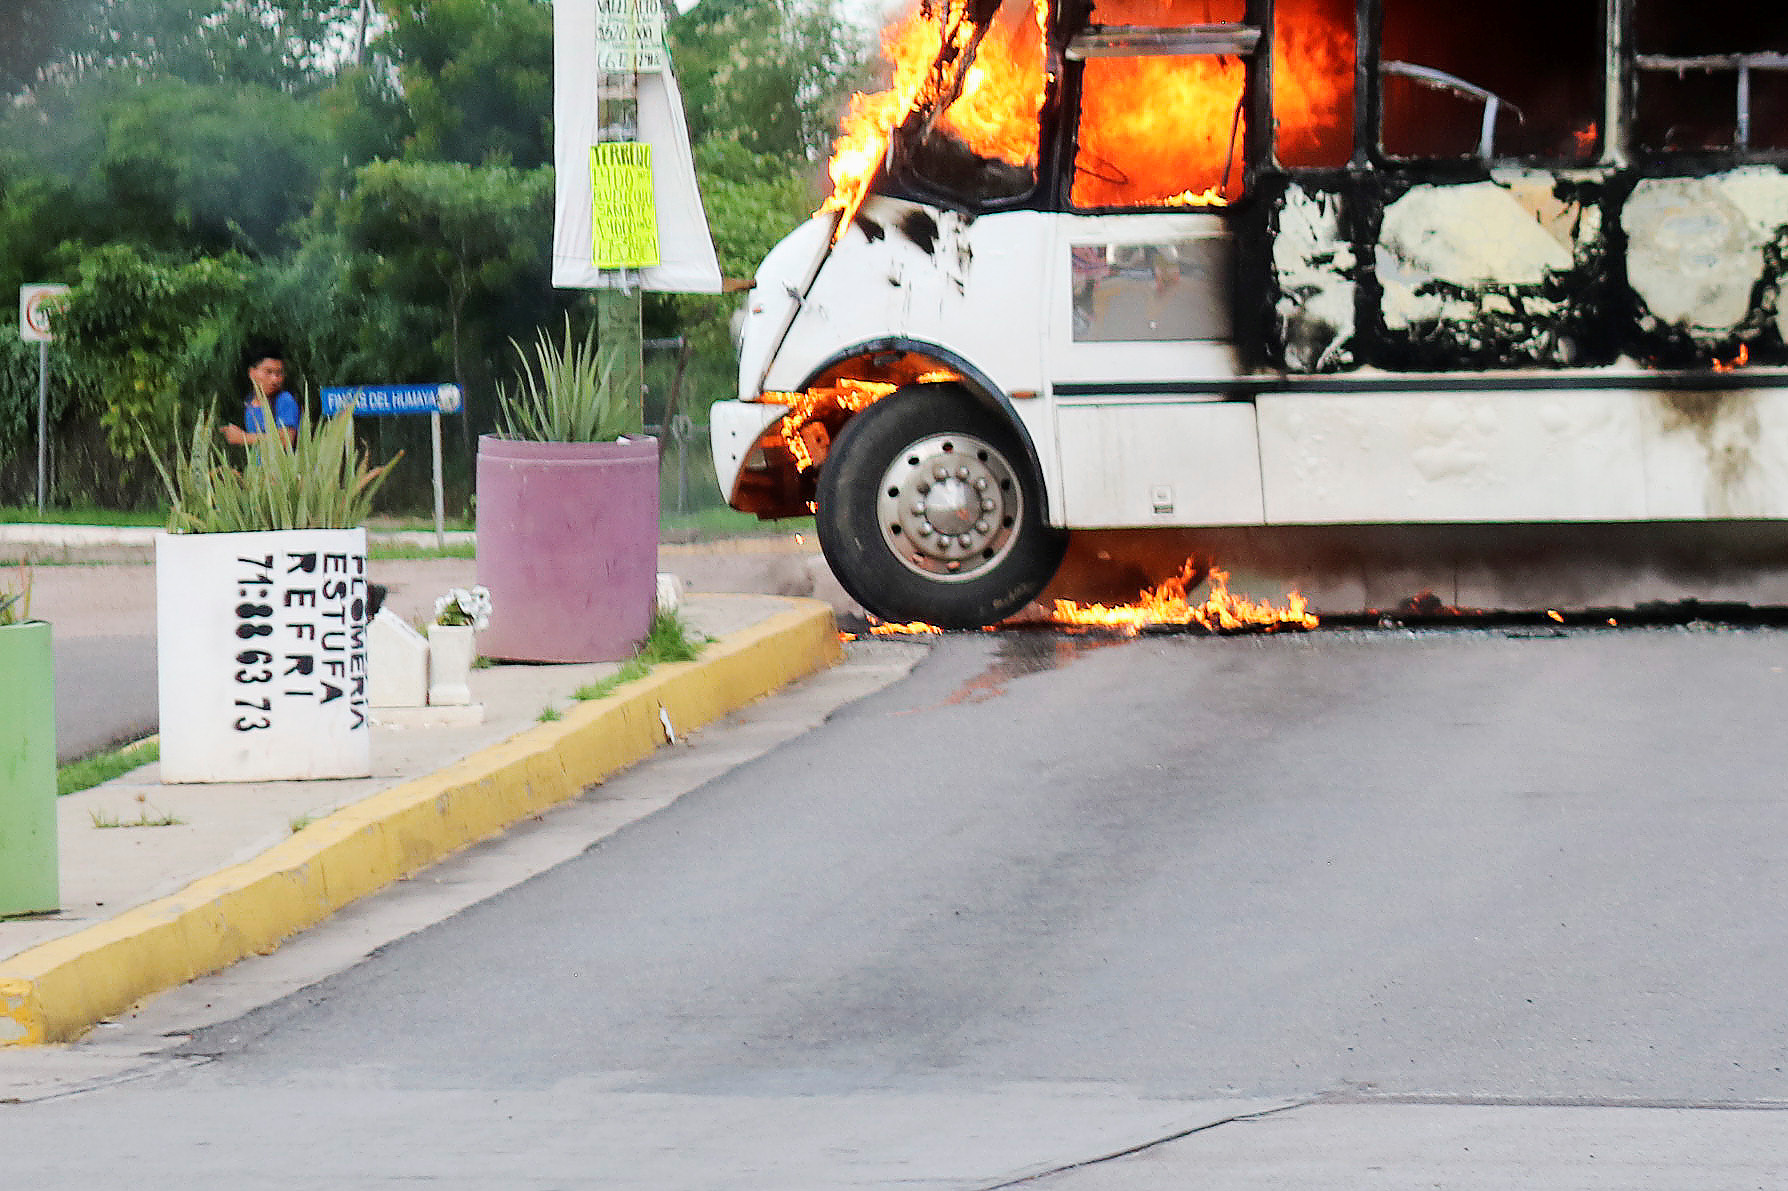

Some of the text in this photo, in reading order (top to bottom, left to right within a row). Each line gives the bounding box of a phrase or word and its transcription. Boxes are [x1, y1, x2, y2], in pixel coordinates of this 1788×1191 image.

[368, 391, 390, 408] DEL
[392, 389, 438, 409] HUMAYA
[284, 552, 316, 697] REFRI
[321, 554, 347, 705] ESTUFA
[235, 649, 273, 684] 63
[233, 697, 272, 732] 73
